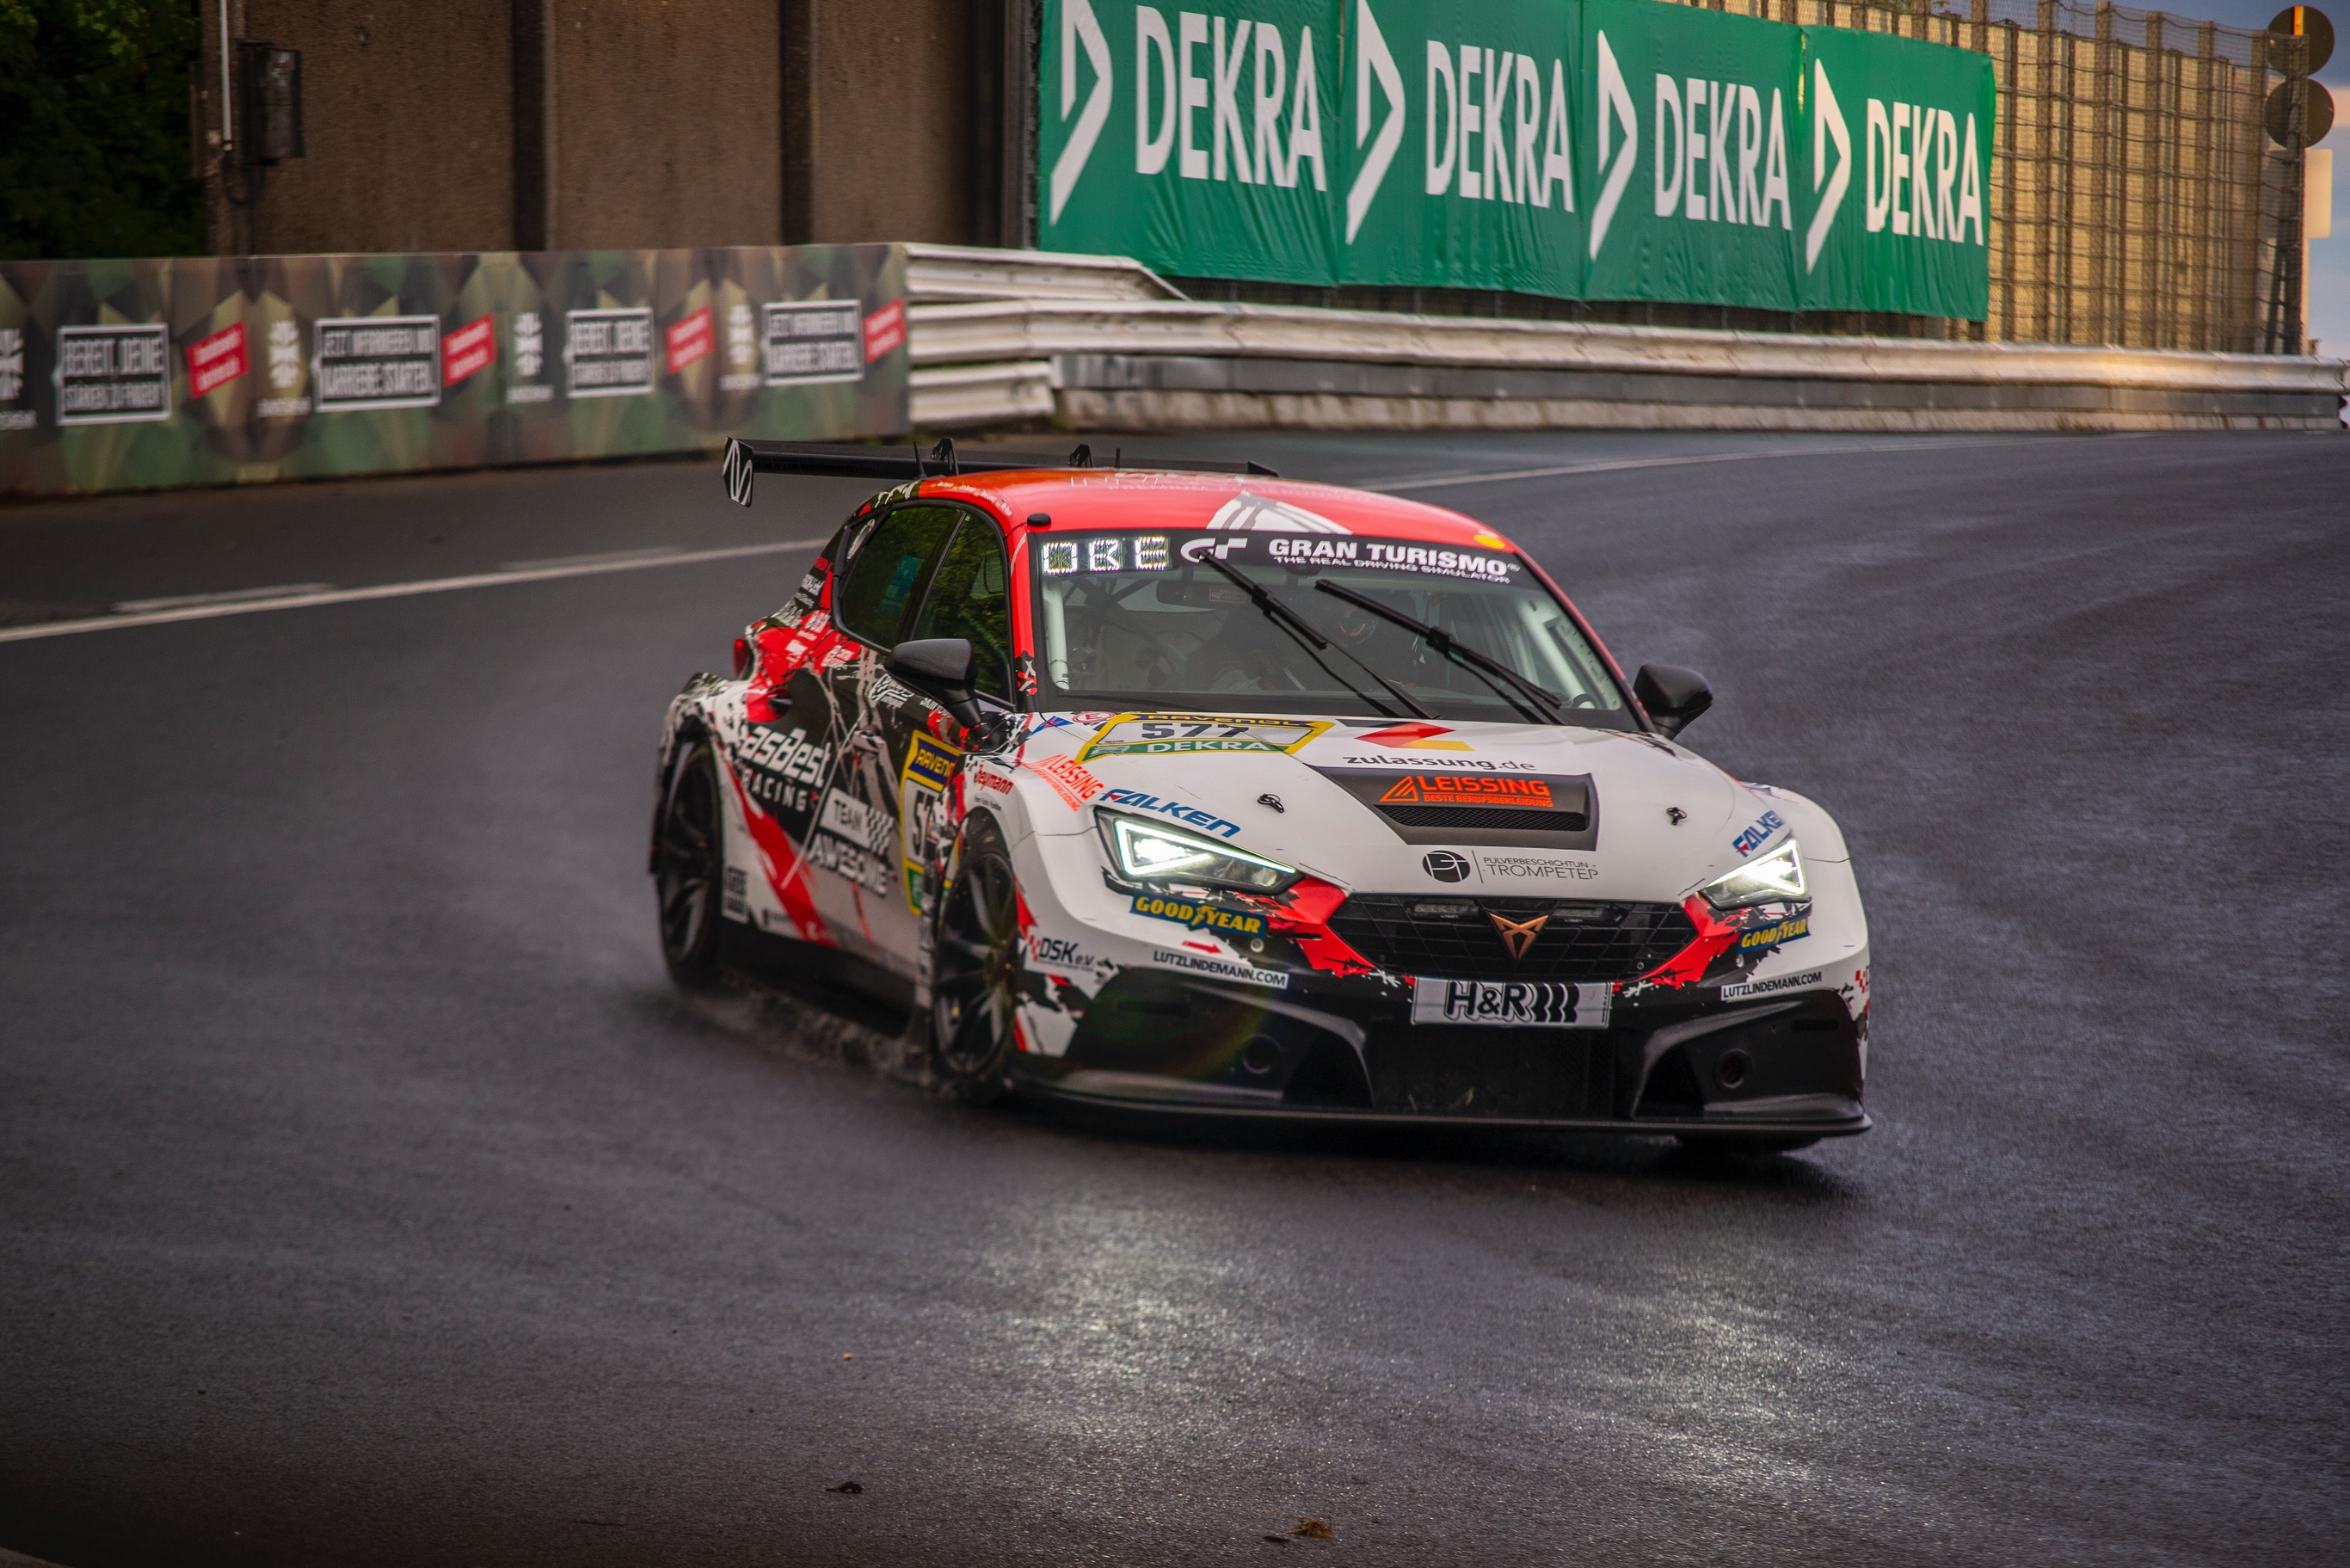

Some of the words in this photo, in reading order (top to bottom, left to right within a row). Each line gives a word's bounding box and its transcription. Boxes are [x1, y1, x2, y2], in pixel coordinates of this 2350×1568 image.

[1135, 4, 1327, 192] DEKRA
[1425, 40, 1575, 212] DEKRA
[1654, 73, 1793, 231] DEKRA
[1866, 98, 1984, 246] DEKRA
[1269, 538, 1357, 558] GRAN
[1273, 556, 1307, 564] THE
[1309, 557, 1351, 567] REAL
[1353, 560, 1418, 572] DRIVING
[1421, 565, 1510, 584] SIMULATOR
[1141, 723, 1250, 740] 577
[1147, 741, 1271, 753] DEKRA
[1047, 753, 1105, 801] LEISSING
[1342, 755, 1537, 772] zulassung.de
[741, 768, 809, 812] RACING
[1417, 775, 1551, 796] LEISSING
[1424, 794, 1455, 802] BESTE
[1456, 795, 1553, 808] BERUFSBEKLEIDUNG
[1098, 788, 1242, 839] FALKEN
[1732, 809, 1787, 858] FALKE
[1483, 857, 1596, 869] PULVERBESCHICHTUN
[1135, 896, 1262, 934] GOODYEAR
[1039, 937, 1079, 963] DSK
[1153, 950, 1287, 987] LUTZLINDEMANN.COM
[1445, 980, 1534, 1022] H&R
[1723, 971, 1823, 999] LUTZLINDEMANN.COM
